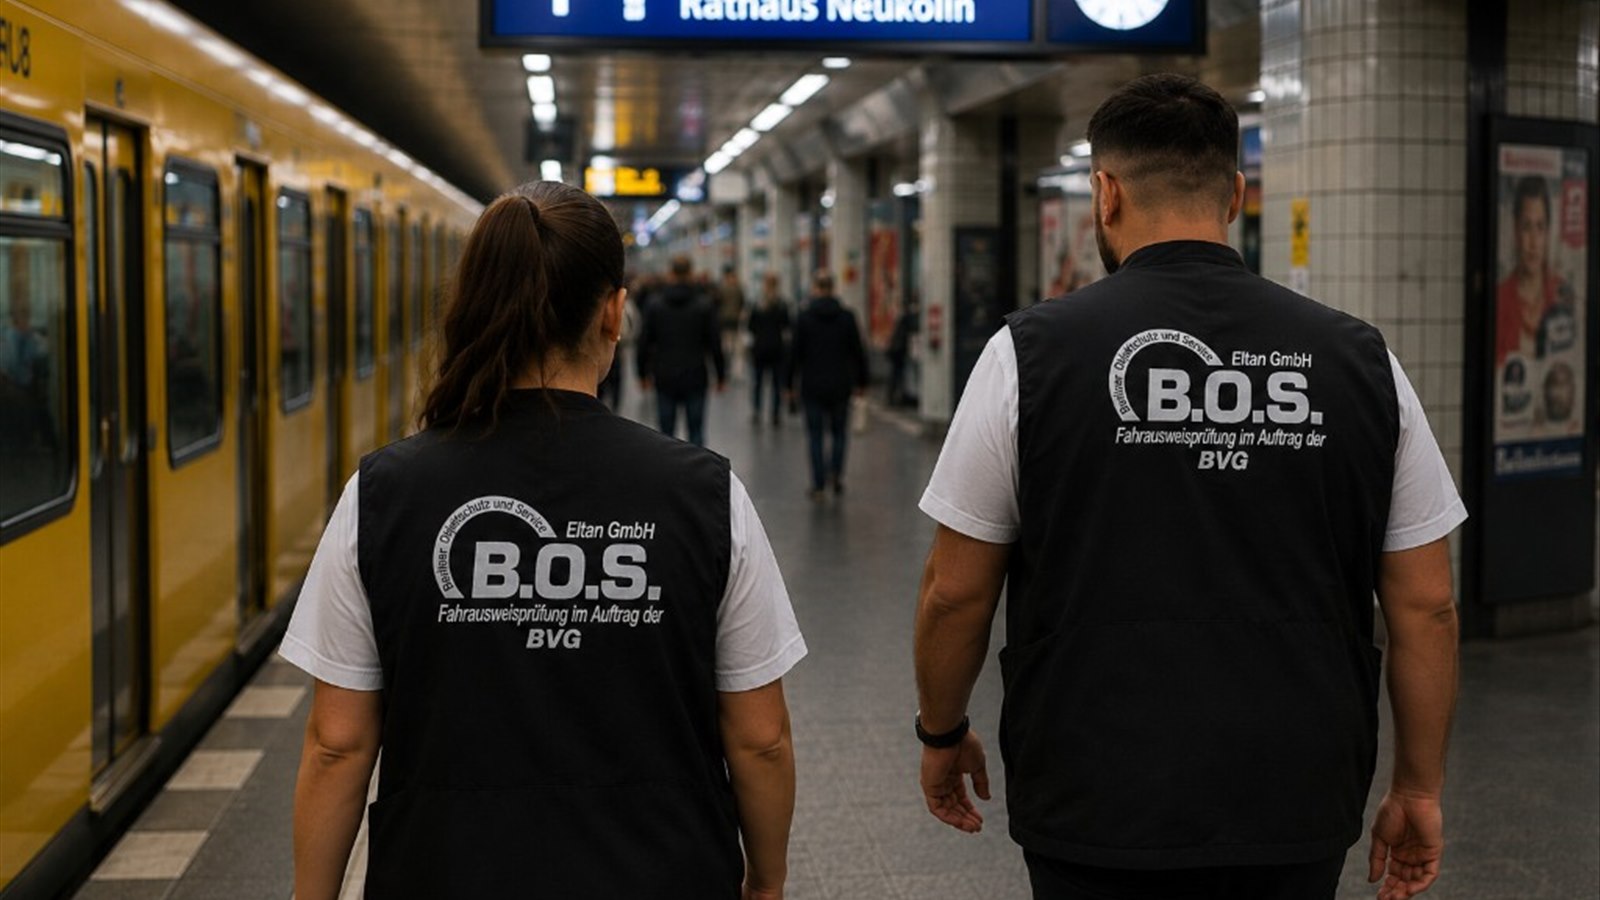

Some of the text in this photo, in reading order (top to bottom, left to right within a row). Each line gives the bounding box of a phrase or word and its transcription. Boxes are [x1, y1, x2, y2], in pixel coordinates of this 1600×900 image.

[1160, 332, 1181, 342] und
[1182, 335, 1214, 362] Service
[1231, 351, 1312, 368] Eltan GmbH
[1147, 368, 1323, 425] B.O.S.
[1115, 426, 1327, 450] Fahrausweisprüfung im Auftrag der
[1197, 450, 1249, 470] BVG
[493, 499, 515, 511] und
[514, 503, 548, 533] Service
[566, 521, 656, 540] Eltan GmbH
[471, 541, 662, 601] B.O.S.
[438, 604, 664, 627] Fahrausweisprüfung im Auftrag der
[526, 628, 582, 649] BVG
